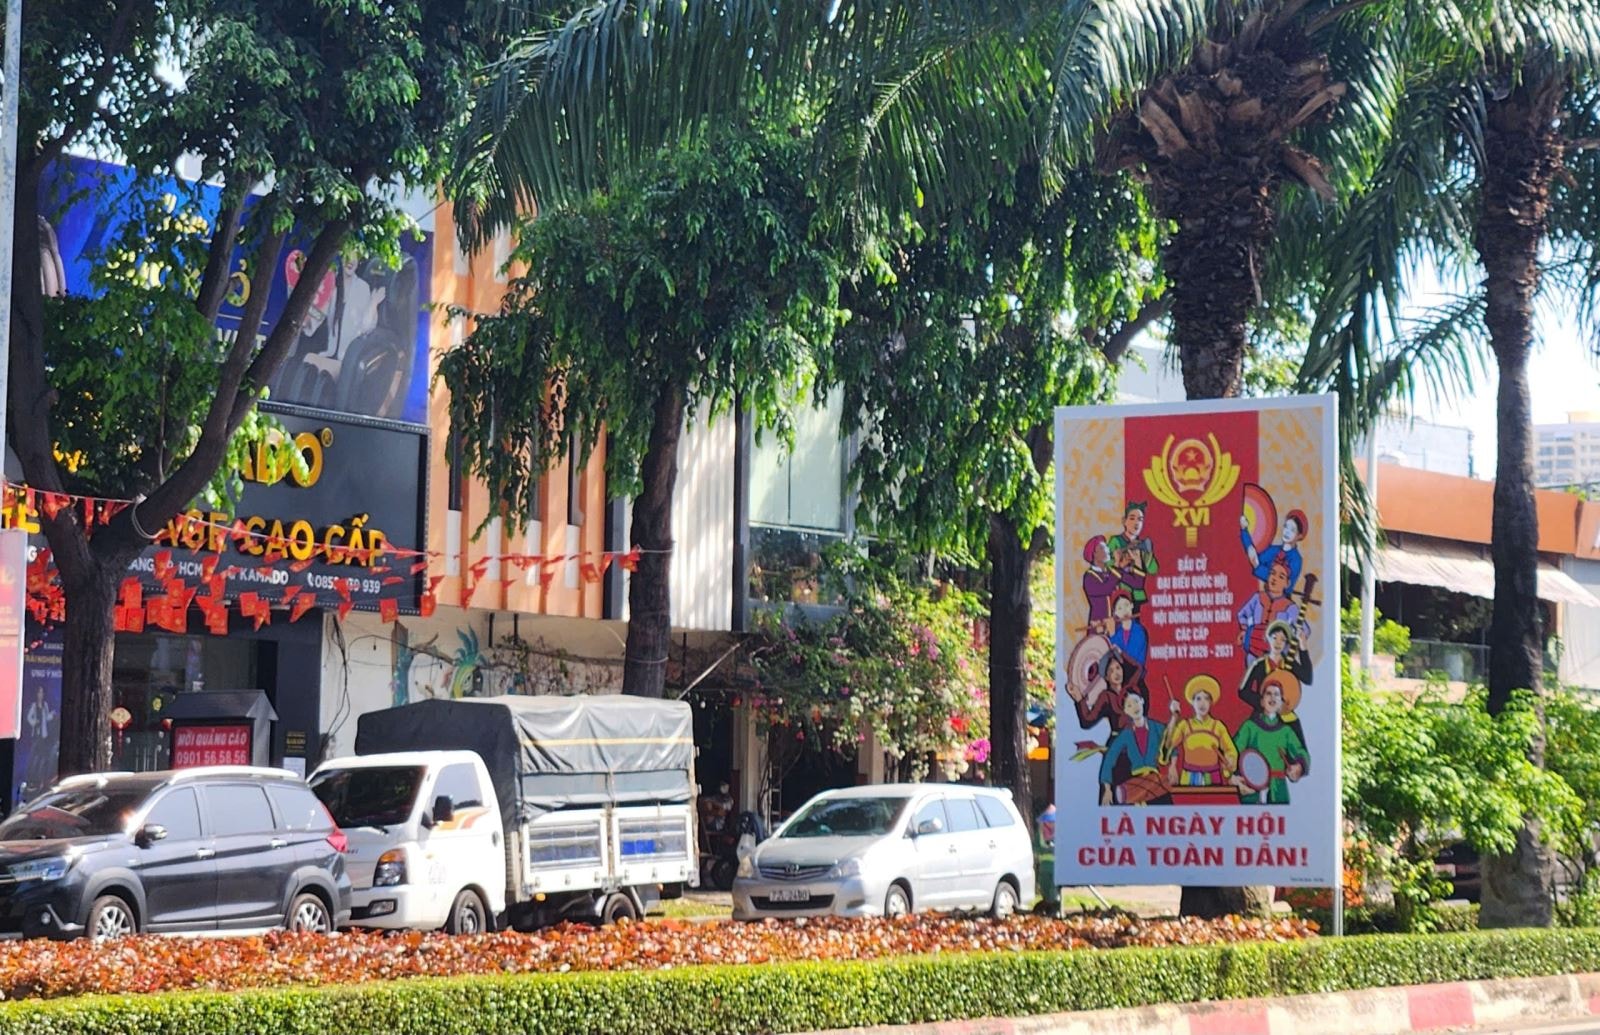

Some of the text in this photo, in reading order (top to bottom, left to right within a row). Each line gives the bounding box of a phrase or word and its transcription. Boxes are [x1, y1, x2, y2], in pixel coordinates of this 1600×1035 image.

[1173, 506, 1210, 527] XVI
[245, 516, 314, 560] CAO
[325, 513, 385, 567] CẤP
[178, 561, 203, 576] HCM
[195, 728, 226, 746] QUẢNG
[228, 730, 248, 745] CÁO
[177, 752, 201, 764] 0901
[1101, 811, 1286, 840] LÀ NGÀY HỘI
[1078, 838, 1308, 867] CỦA TOÀN DÂN!
